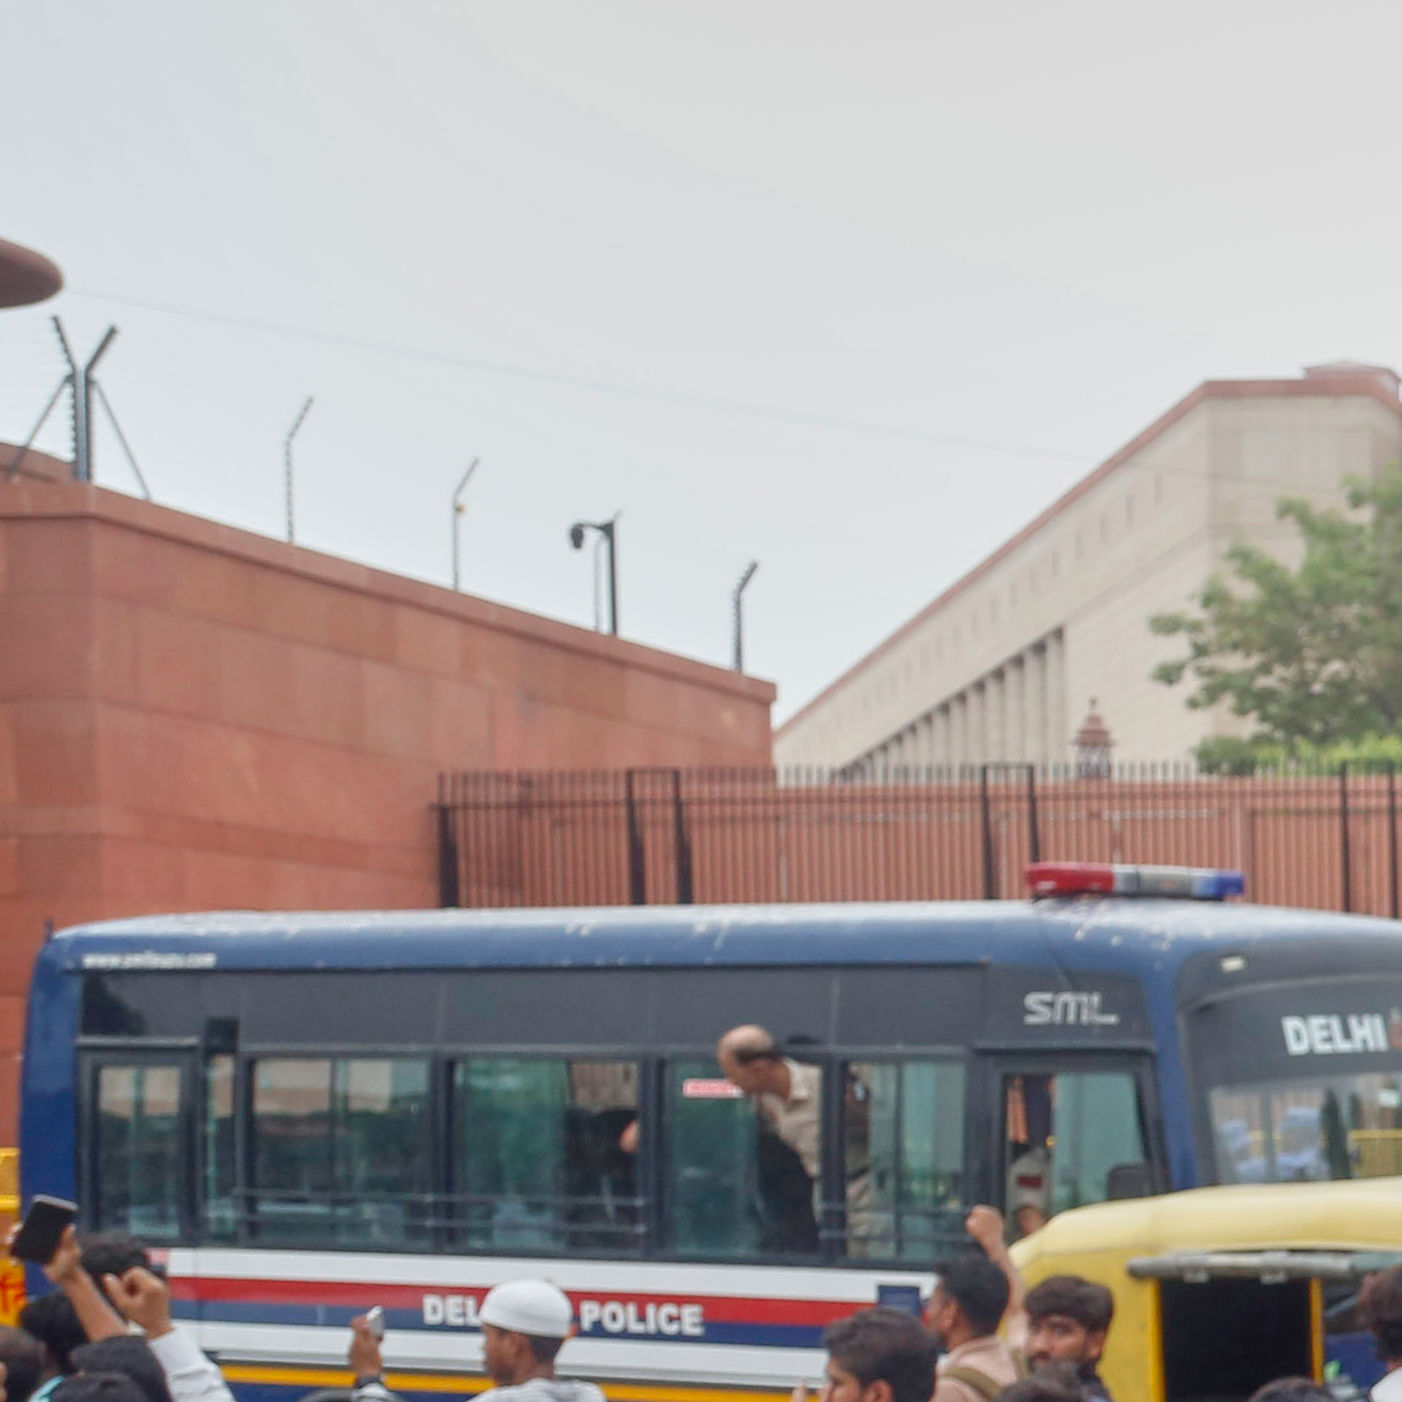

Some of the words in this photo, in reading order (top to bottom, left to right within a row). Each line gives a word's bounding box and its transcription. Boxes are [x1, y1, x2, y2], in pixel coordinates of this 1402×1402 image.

[1024, 991, 1119, 1025] SML
[1281, 1014, 1388, 1056] DELHI
[422, 1294, 481, 1326] DEL
[579, 1300, 705, 1336] POLICE
